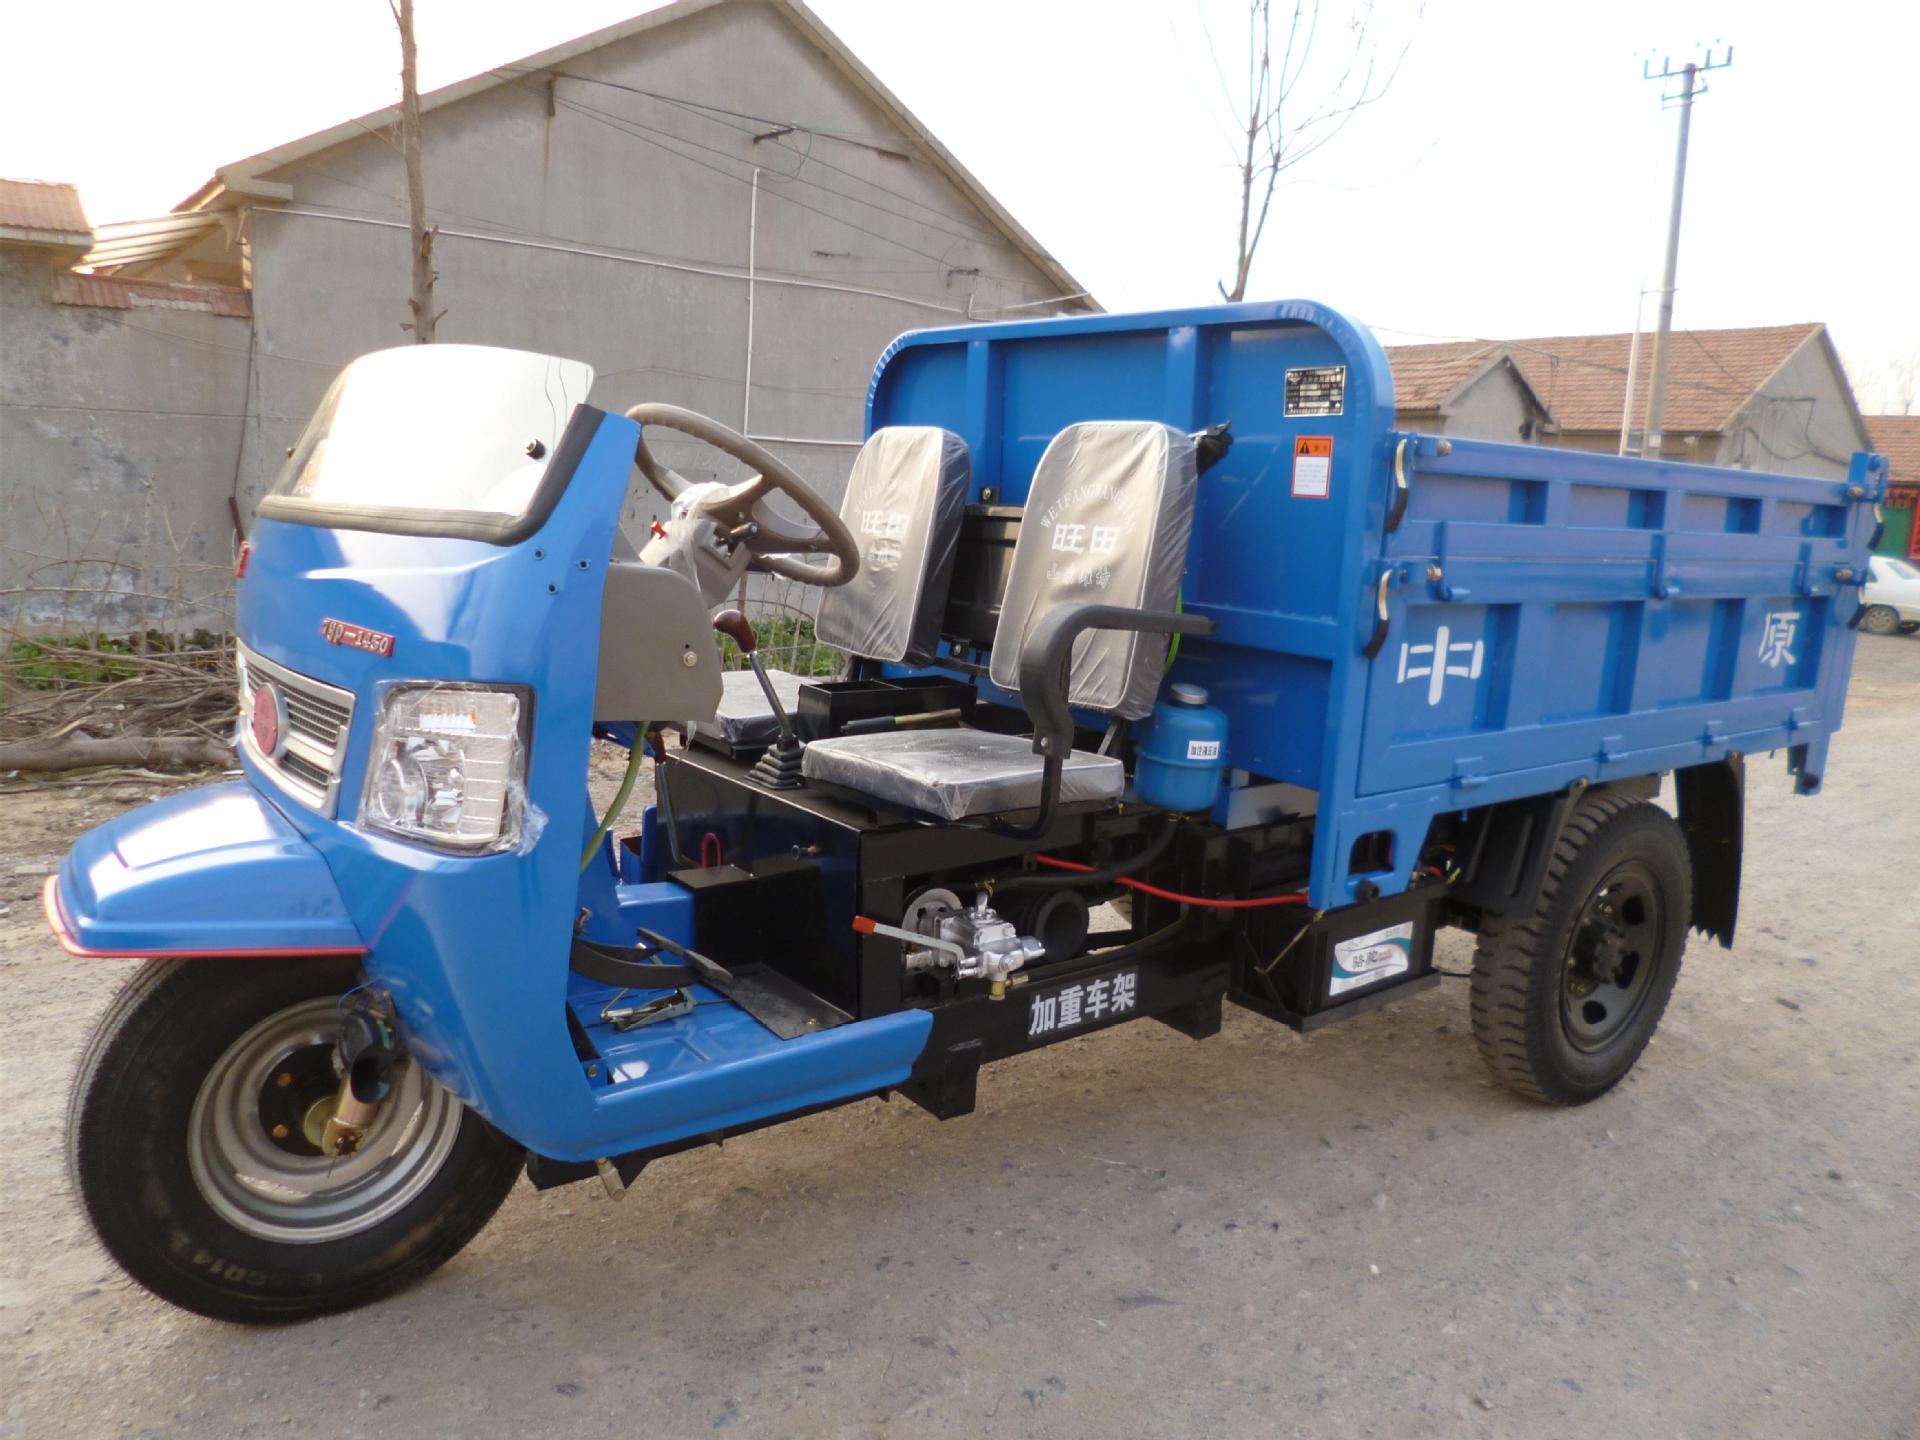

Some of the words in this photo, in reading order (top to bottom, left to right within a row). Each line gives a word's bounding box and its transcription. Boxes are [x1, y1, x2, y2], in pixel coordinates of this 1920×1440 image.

[1051, 523, 1120, 555] 旺田
[1397, 625, 1484, 705] 中
[1758, 611, 1800, 668] 原
[1028, 972, 1136, 1036] 加重车架
